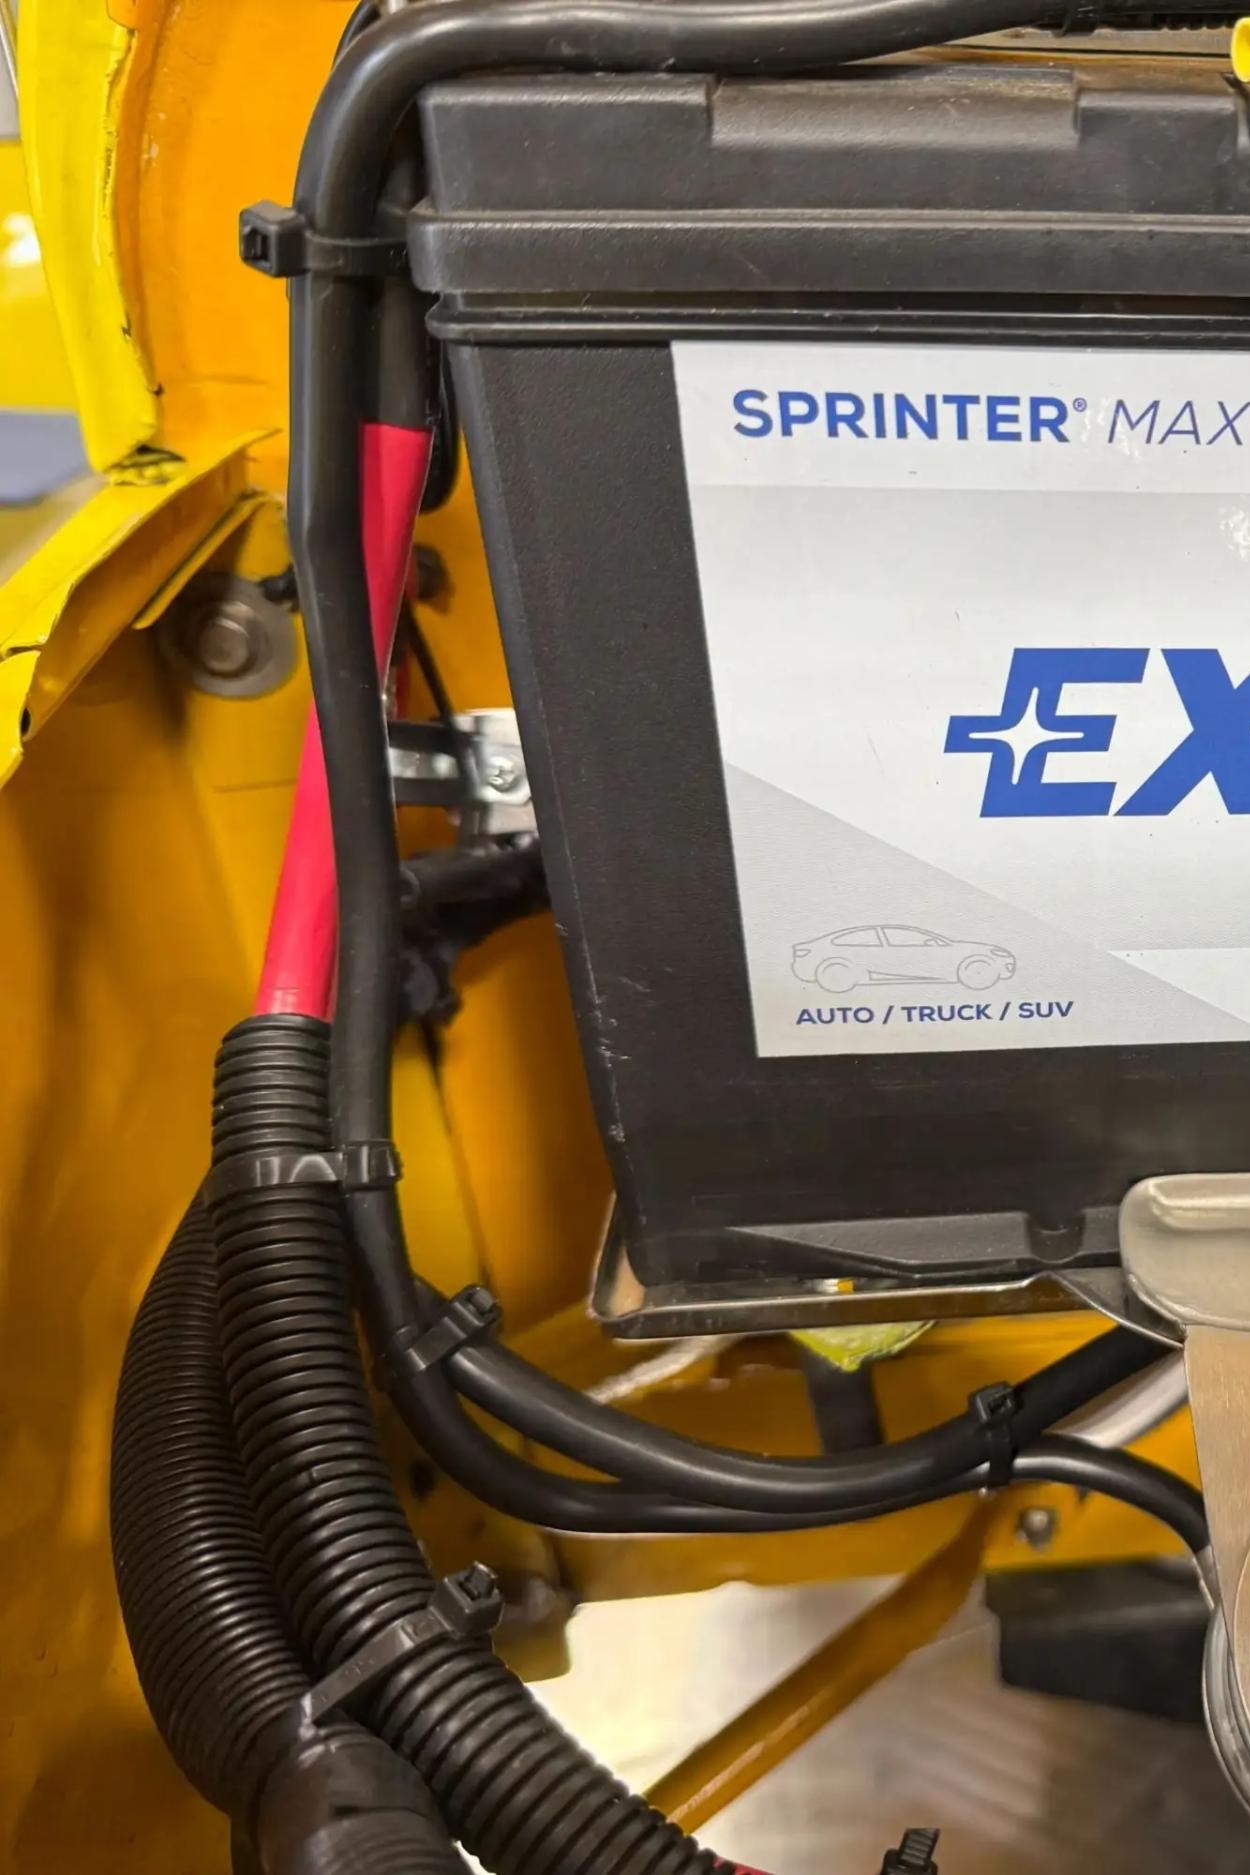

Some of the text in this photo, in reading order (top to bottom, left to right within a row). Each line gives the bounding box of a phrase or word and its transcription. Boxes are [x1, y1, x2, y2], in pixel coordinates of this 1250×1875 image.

[796, 1006, 875, 1025] AUTO
[901, 1003, 993, 1023] TRUCK
[1018, 1001, 1075, 1019] SUV
